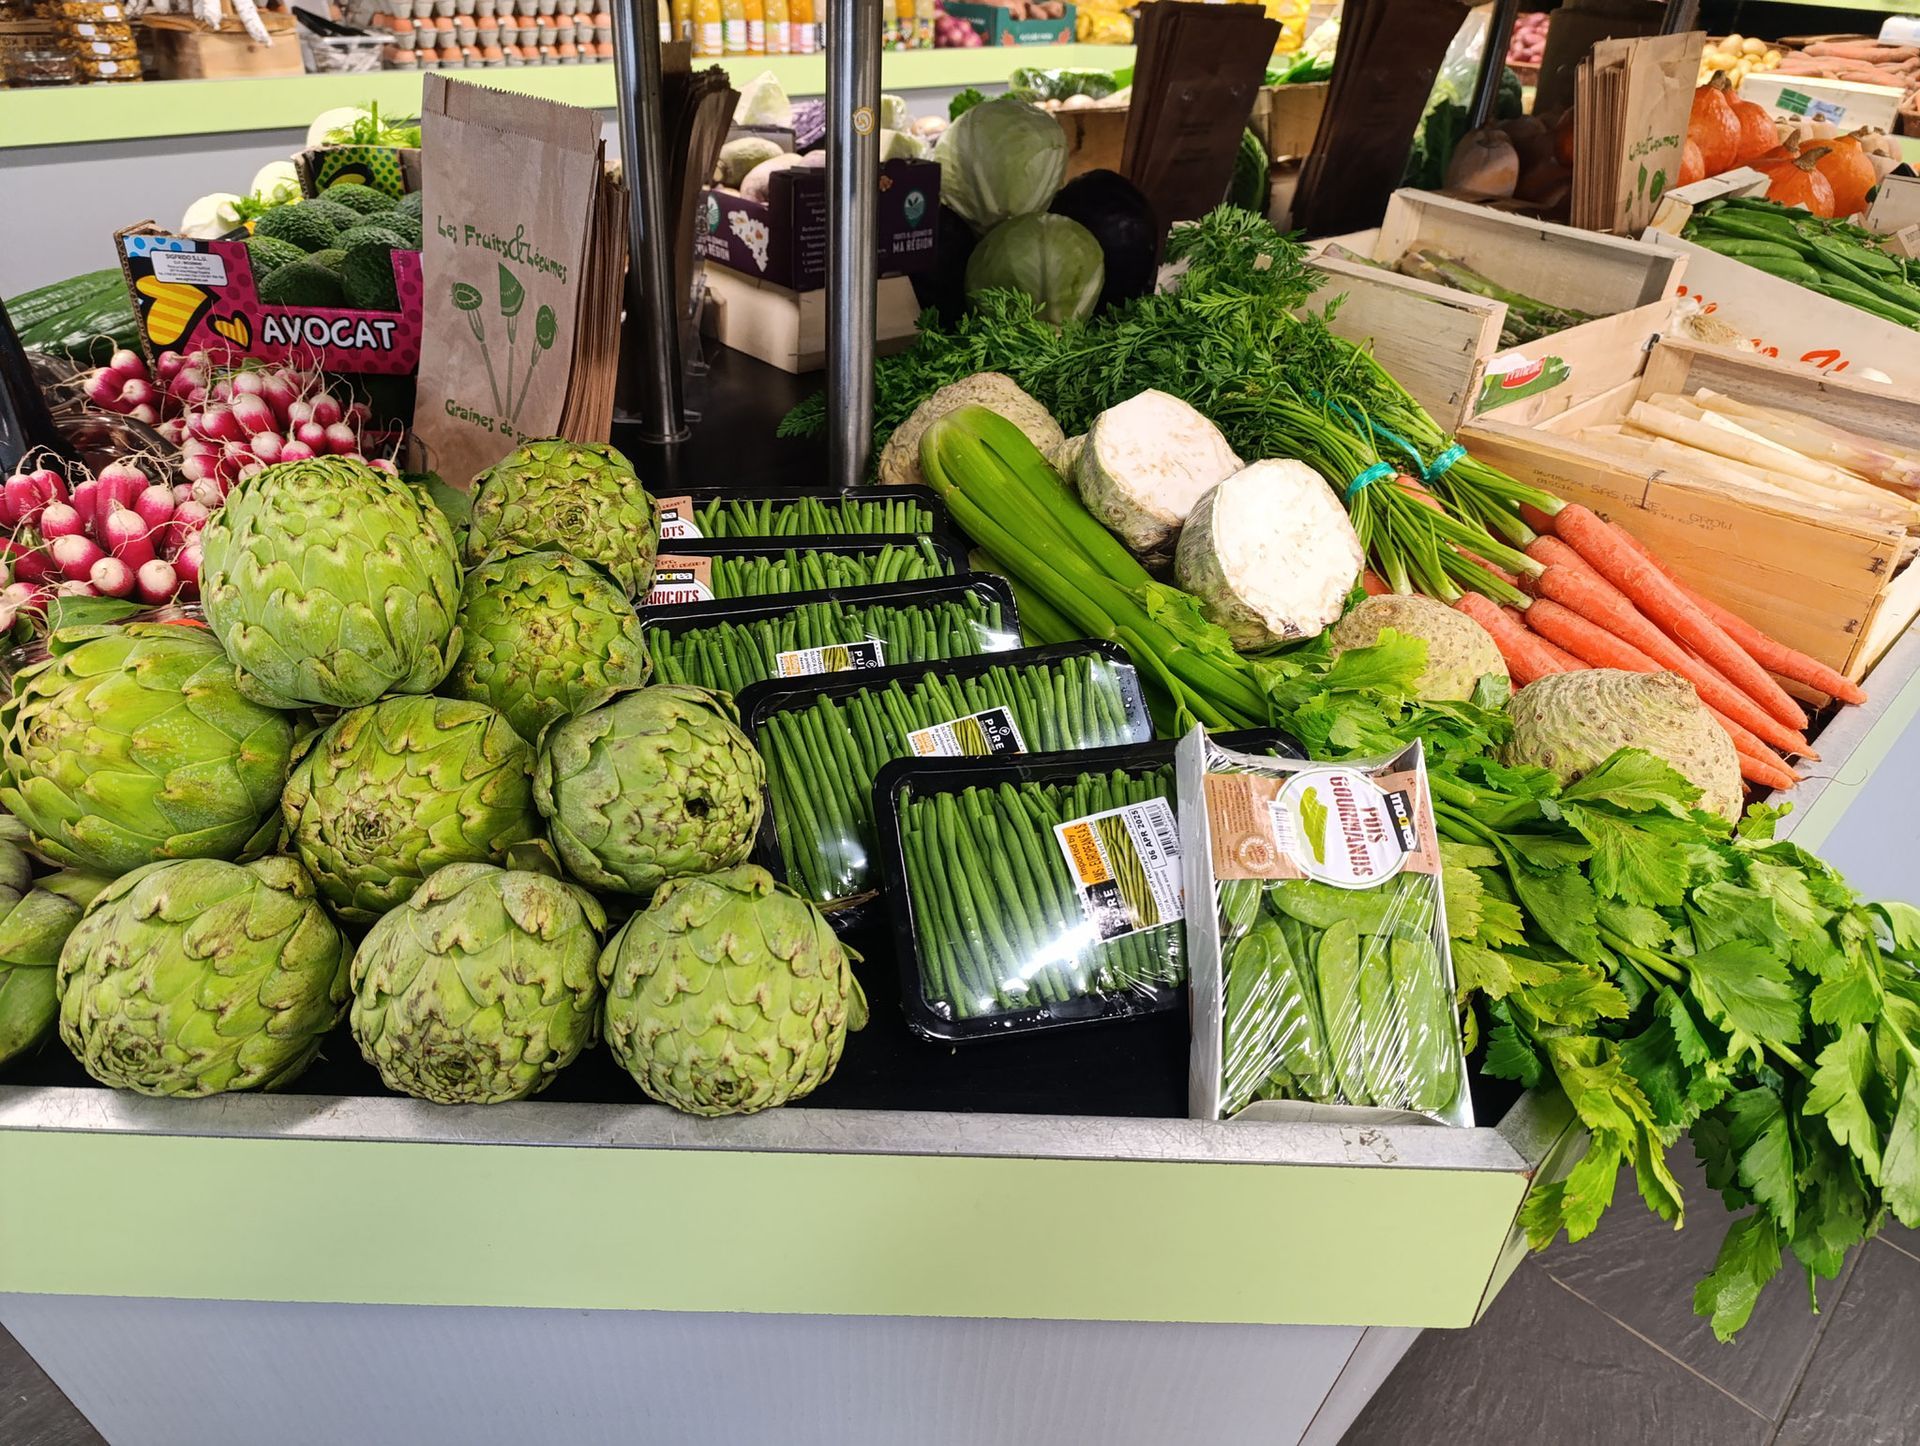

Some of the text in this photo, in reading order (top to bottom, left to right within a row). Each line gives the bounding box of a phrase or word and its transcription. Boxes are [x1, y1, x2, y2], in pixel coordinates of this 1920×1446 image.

[438, 215, 457, 243] Les
[464, 224, 507, 258] Fruits
[527, 243, 567, 284] Légumes
[263, 315, 396, 349] AVOCAT
[445, 399, 494, 432] Graines
[500, 420, 513, 437] de
[985, 718, 1005, 750] PURE
[1131, 810, 1158, 861] 06 APR 2025
[1329, 776, 1373, 876] GOURMANDS
[1361, 806, 1388, 843] POIS
[1389, 792, 1416, 850] moorea
[1067, 833, 1078, 844] by
[1079, 834, 1102, 867] EUROPEAN
[1096, 842, 1105, 856] Vert
[1068, 843, 1089, 877] Imported
[1092, 869, 1107, 882] AMS
[1140, 856, 1154, 879] Kenya
[1149, 880, 1156, 889] of
[1103, 888, 1126, 928] PURE
